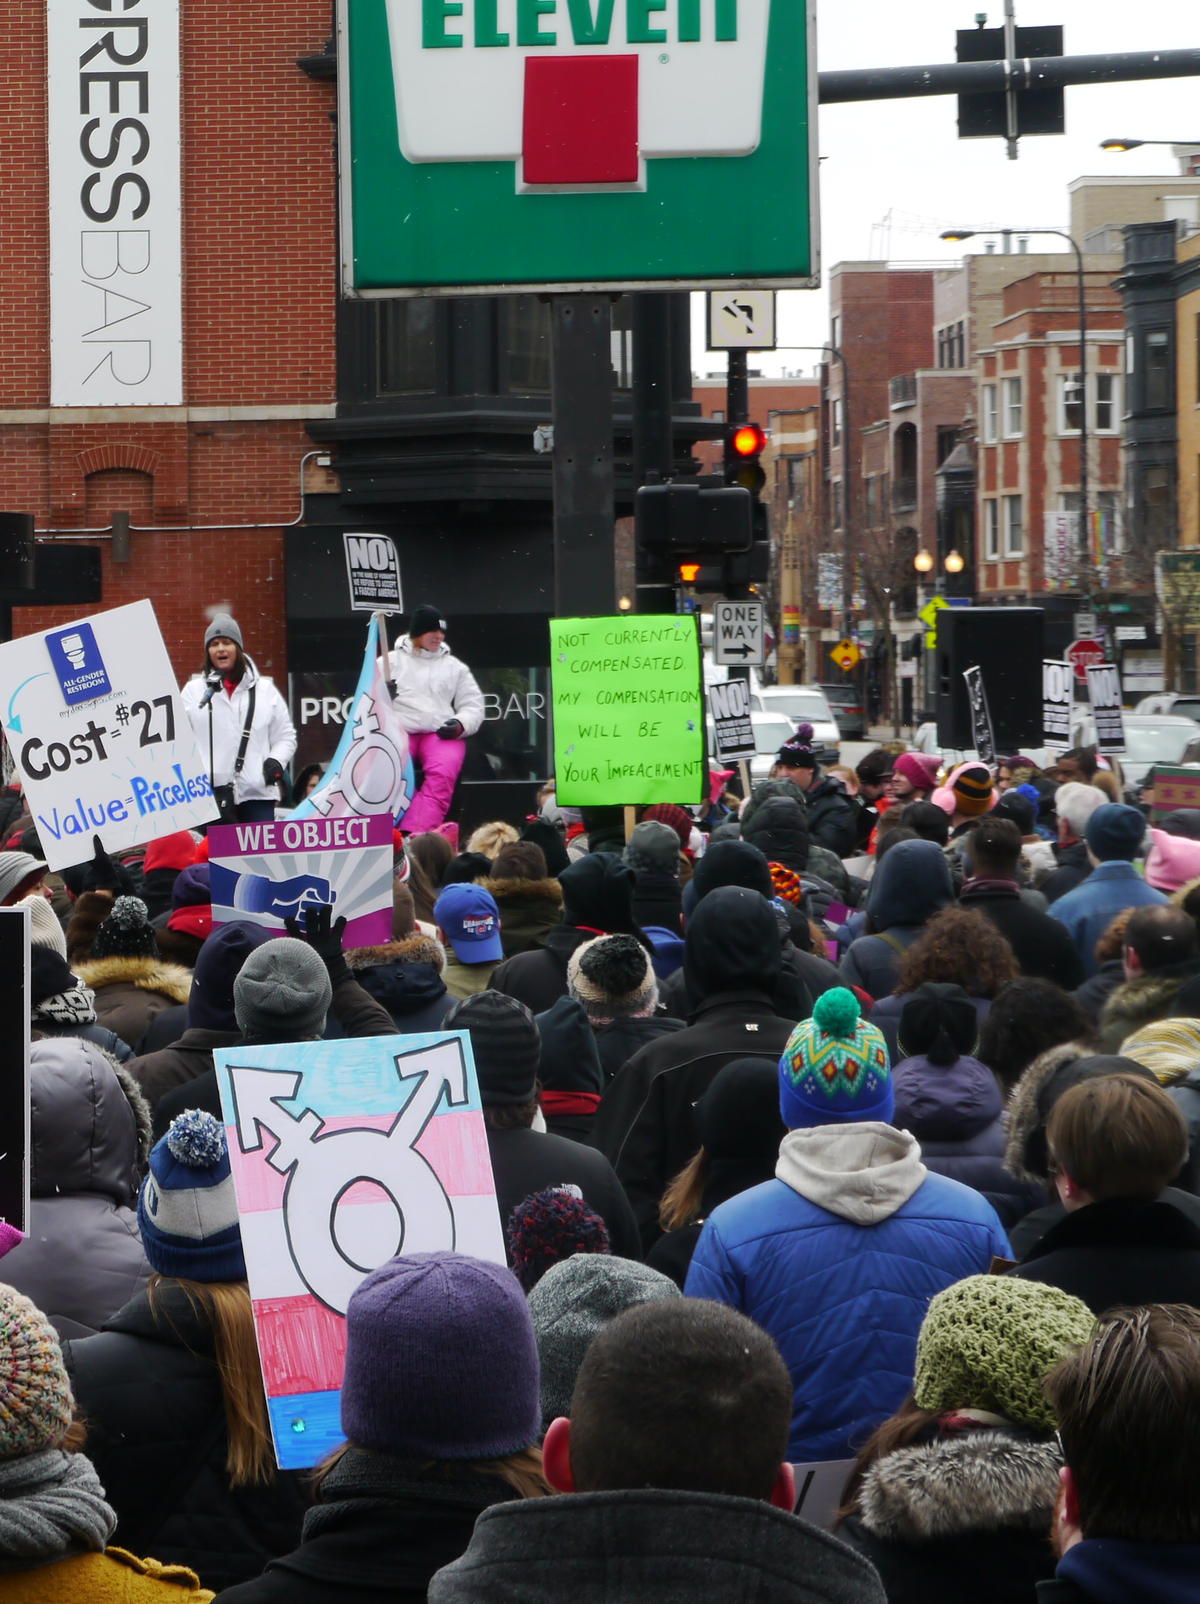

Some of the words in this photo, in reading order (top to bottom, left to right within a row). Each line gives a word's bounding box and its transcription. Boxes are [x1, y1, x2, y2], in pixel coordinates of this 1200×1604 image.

[348, 538, 396, 571] NO!
[722, 607, 758, 621] ONE
[558, 633, 590, 648] NOT
[604, 627, 692, 646] CURRENTLY
[721, 625, 758, 639] WAY
[63, 670, 105, 688] ALL-GENDER
[67, 677, 105, 694] RESTROOM
[558, 692, 582, 704] MY
[596, 688, 699, 705] COMPENSATION
[709, 683, 750, 719] NO!
[578, 724, 621, 739] WILL
[638, 721, 662, 737] BE
[564, 762, 600, 783] YOUR
[605, 759, 702, 780] IMPEACHMENT
[236, 824, 276, 852] WE
[283, 818, 370, 848] OBJECT
